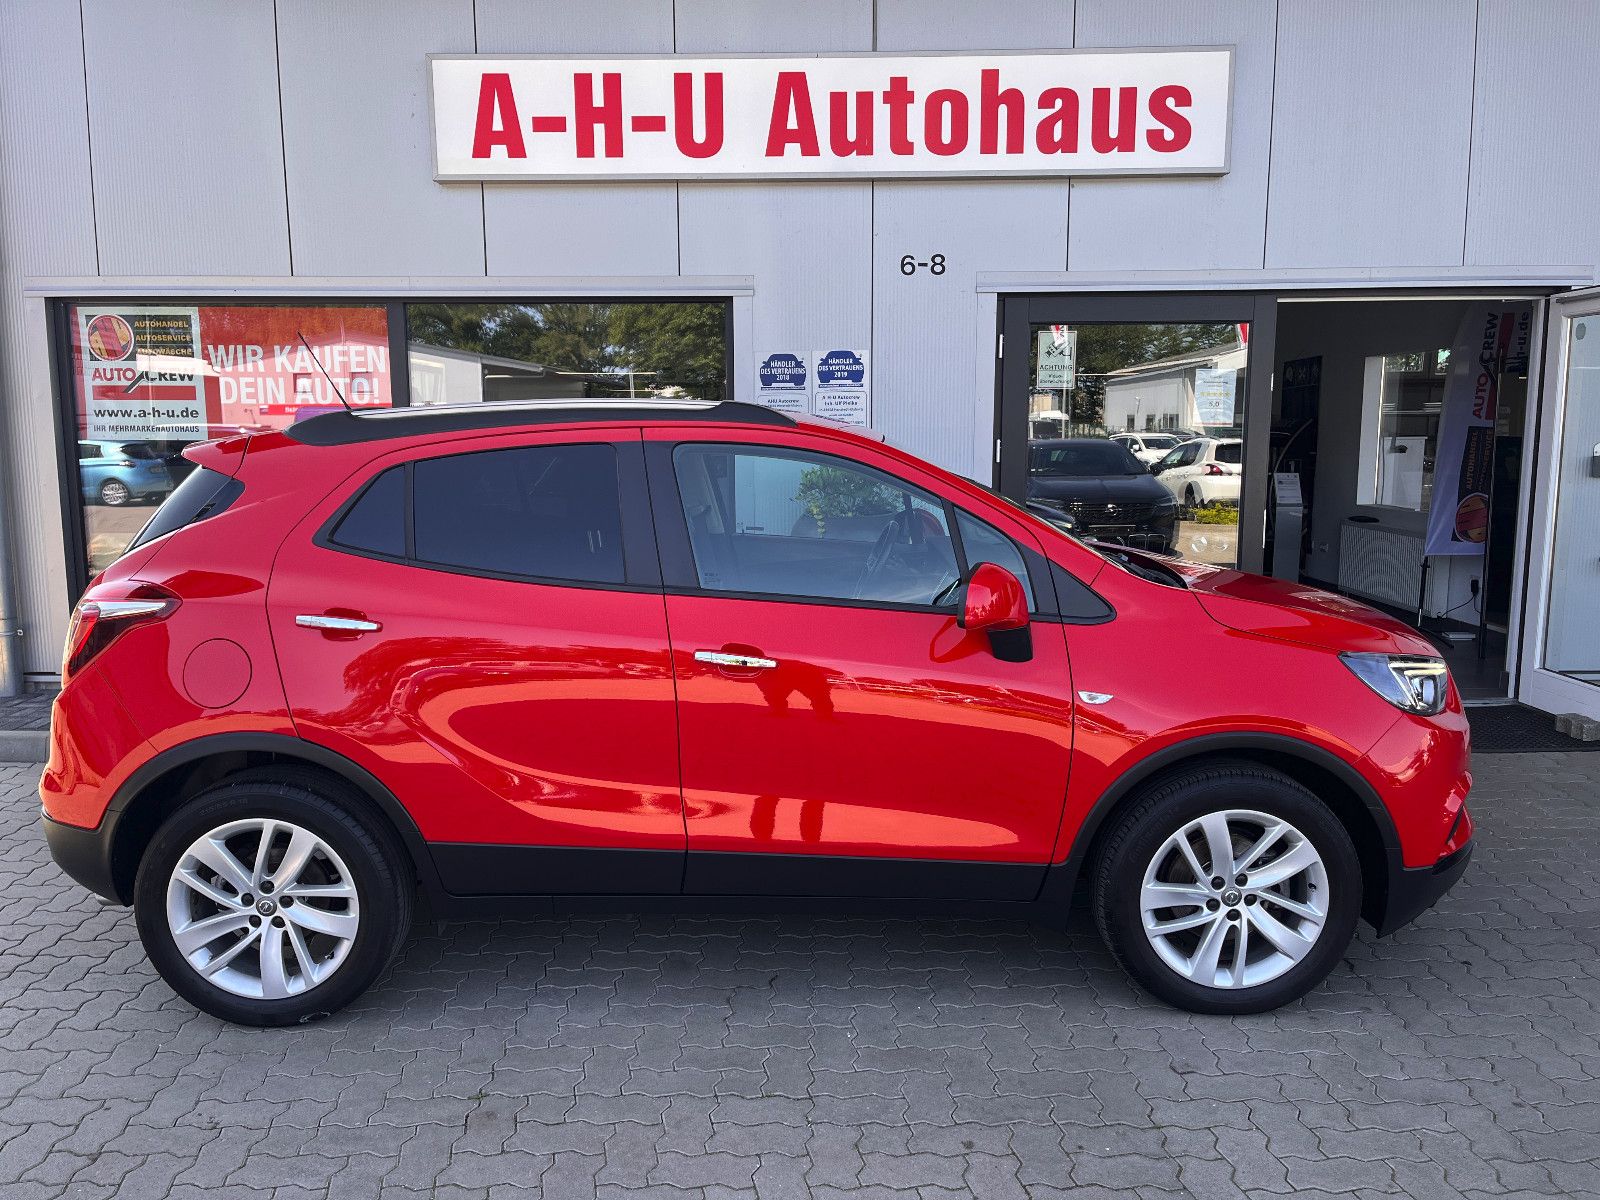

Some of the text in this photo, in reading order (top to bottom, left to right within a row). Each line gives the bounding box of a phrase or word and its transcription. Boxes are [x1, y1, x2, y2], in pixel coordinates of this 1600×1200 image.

[472, 69, 1191, 159] A-H-U Autohaus
[900, 254, 946, 275] 6-8
[134, 320, 189, 328] AUTOHANDEL
[135, 334, 192, 342] AUTOSERVICE
[208, 344, 386, 374] WIR KAUFEN
[770, 360, 796, 368] HÄNDLER
[828, 357, 853, 365] HÄNDLER
[760, 367, 806, 376] DES VERTRAUENS
[818, 364, 864, 372] DES VERTRAUENS
[92, 367, 137, 382] AUTO
[220, 377, 380, 405] DEIN AUTO!
[1472, 372, 1489, 419] AUTO
[93, 407, 200, 419] www.a-h-u.de
[108, 425, 200, 433] MEHRMARKENAUTOHAUS
